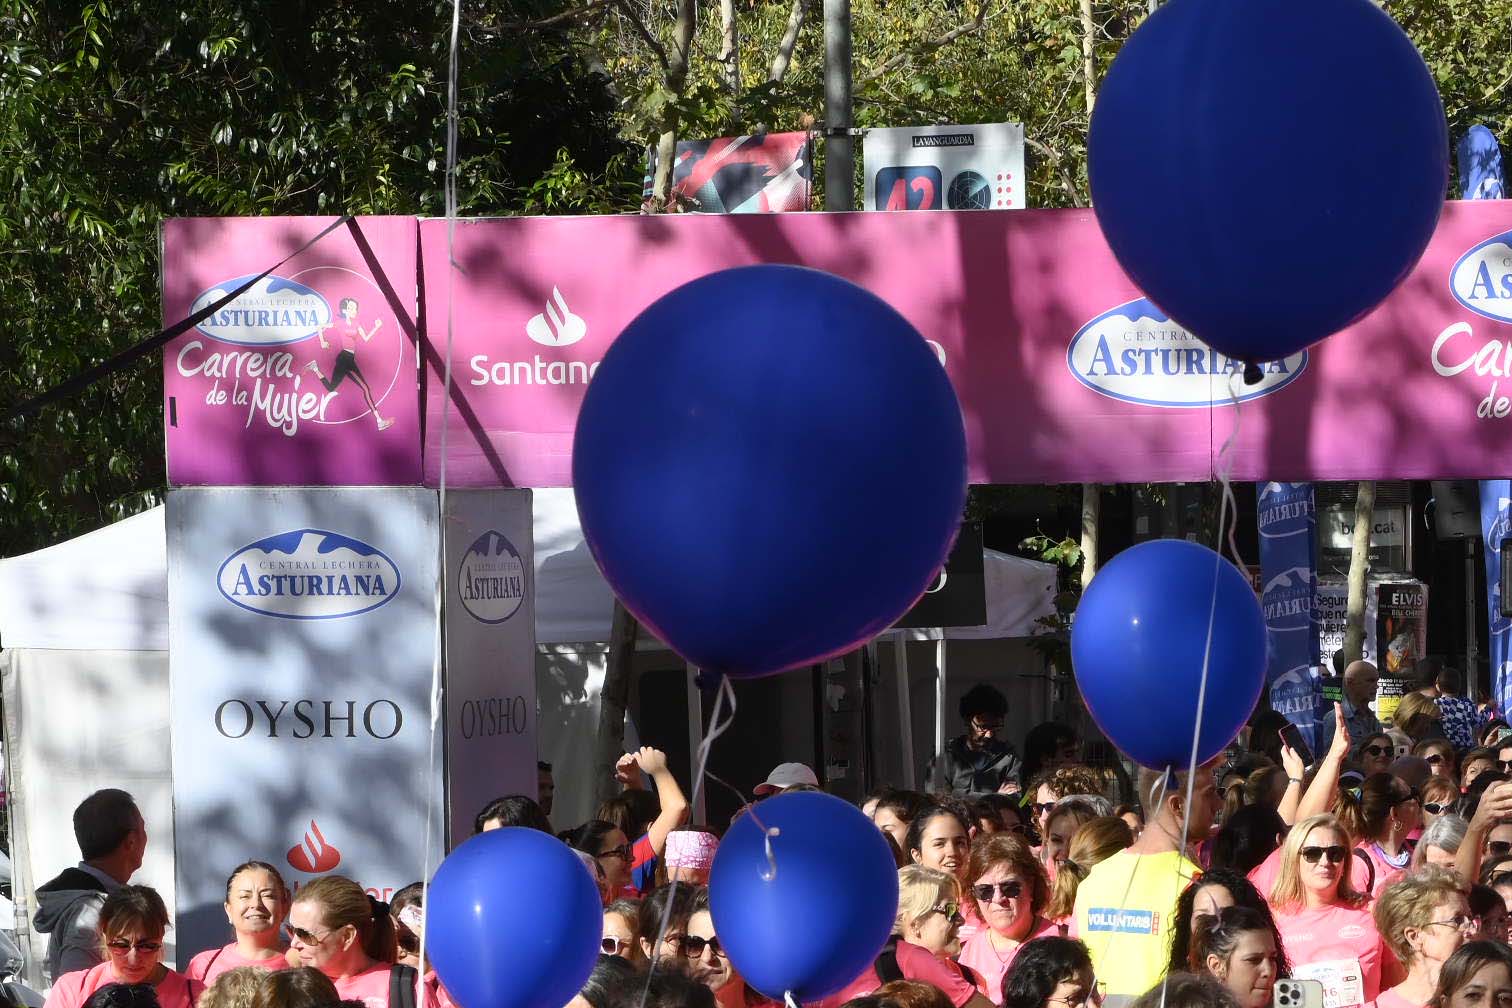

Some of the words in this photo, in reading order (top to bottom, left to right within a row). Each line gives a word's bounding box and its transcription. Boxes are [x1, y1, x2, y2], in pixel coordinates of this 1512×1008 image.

[200, 301, 320, 327] ASTURIANA
[177, 341, 294, 377] Carrera
[470, 354, 601, 386] Santan
[206, 379, 227, 405] de
[233, 380, 248, 405] la
[245, 375, 339, 437] Mujer
[1477, 380, 1511, 418] de
[232, 562, 388, 597] ASTURIANA
[259, 560, 317, 570] CENTRAL
[321, 560, 381, 570] LECHERA
[464, 570, 522, 602] ASTURIANA
[1392, 592, 1424, 605] ELVIS
[213, 698, 403, 739] OYSHO
[461, 695, 527, 740] OYSHO
[1088, 913, 1152, 929] VOLUNTARIS
